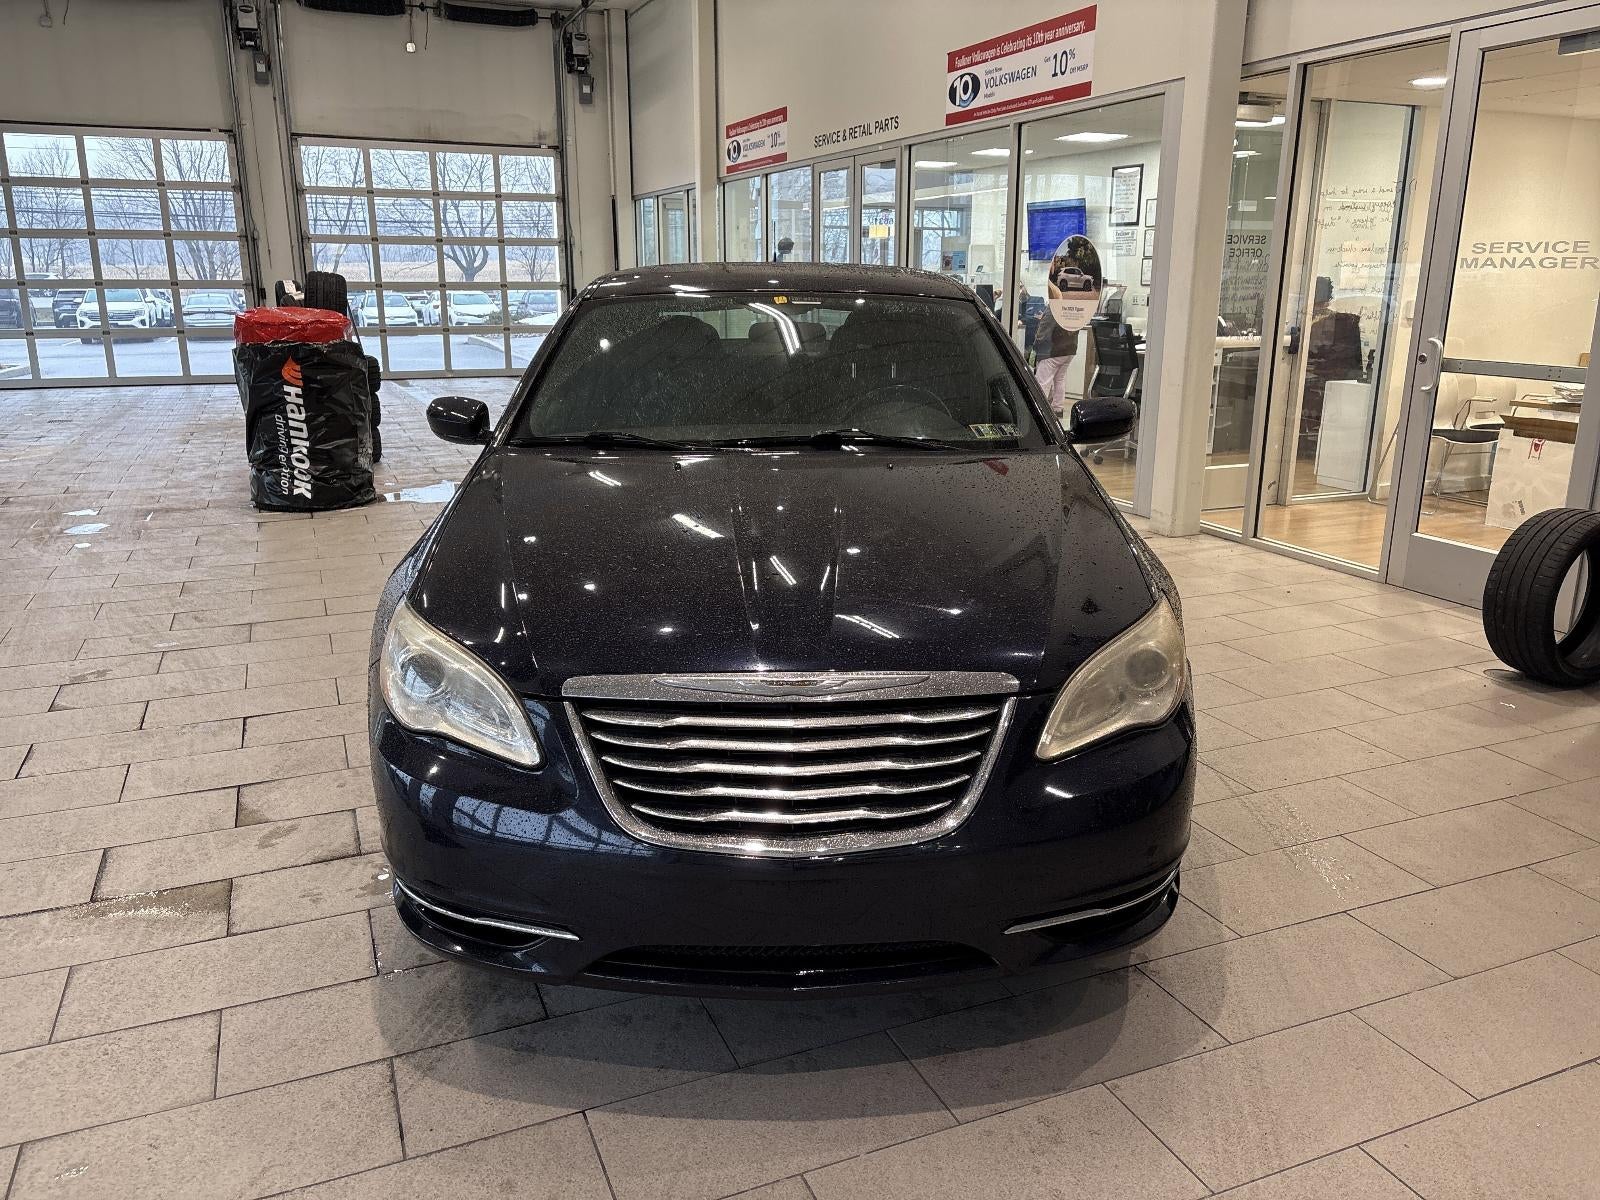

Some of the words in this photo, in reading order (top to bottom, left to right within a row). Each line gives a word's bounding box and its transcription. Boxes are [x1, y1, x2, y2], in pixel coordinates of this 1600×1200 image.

[972, 47, 997, 63] Volkswagen
[1001, 37, 1026, 54] Celebrating
[1033, 31, 1044, 45] 10th
[1044, 28, 1056, 44] year
[984, 65, 1038, 89] VOLKSWAGEN
[1077, 63, 1089, 73] MSRP
[813, 130, 841, 149] SERVICE
[841, 128, 847, 142] &
[848, 123, 873, 140] RETAIL
[874, 115, 900, 135] PARTS
[1471, 240, 1591, 255] SERVICE
[1459, 256, 1600, 270] MANAGER
[274, 413, 290, 454] driving
[278, 454, 290, 496] eotion
